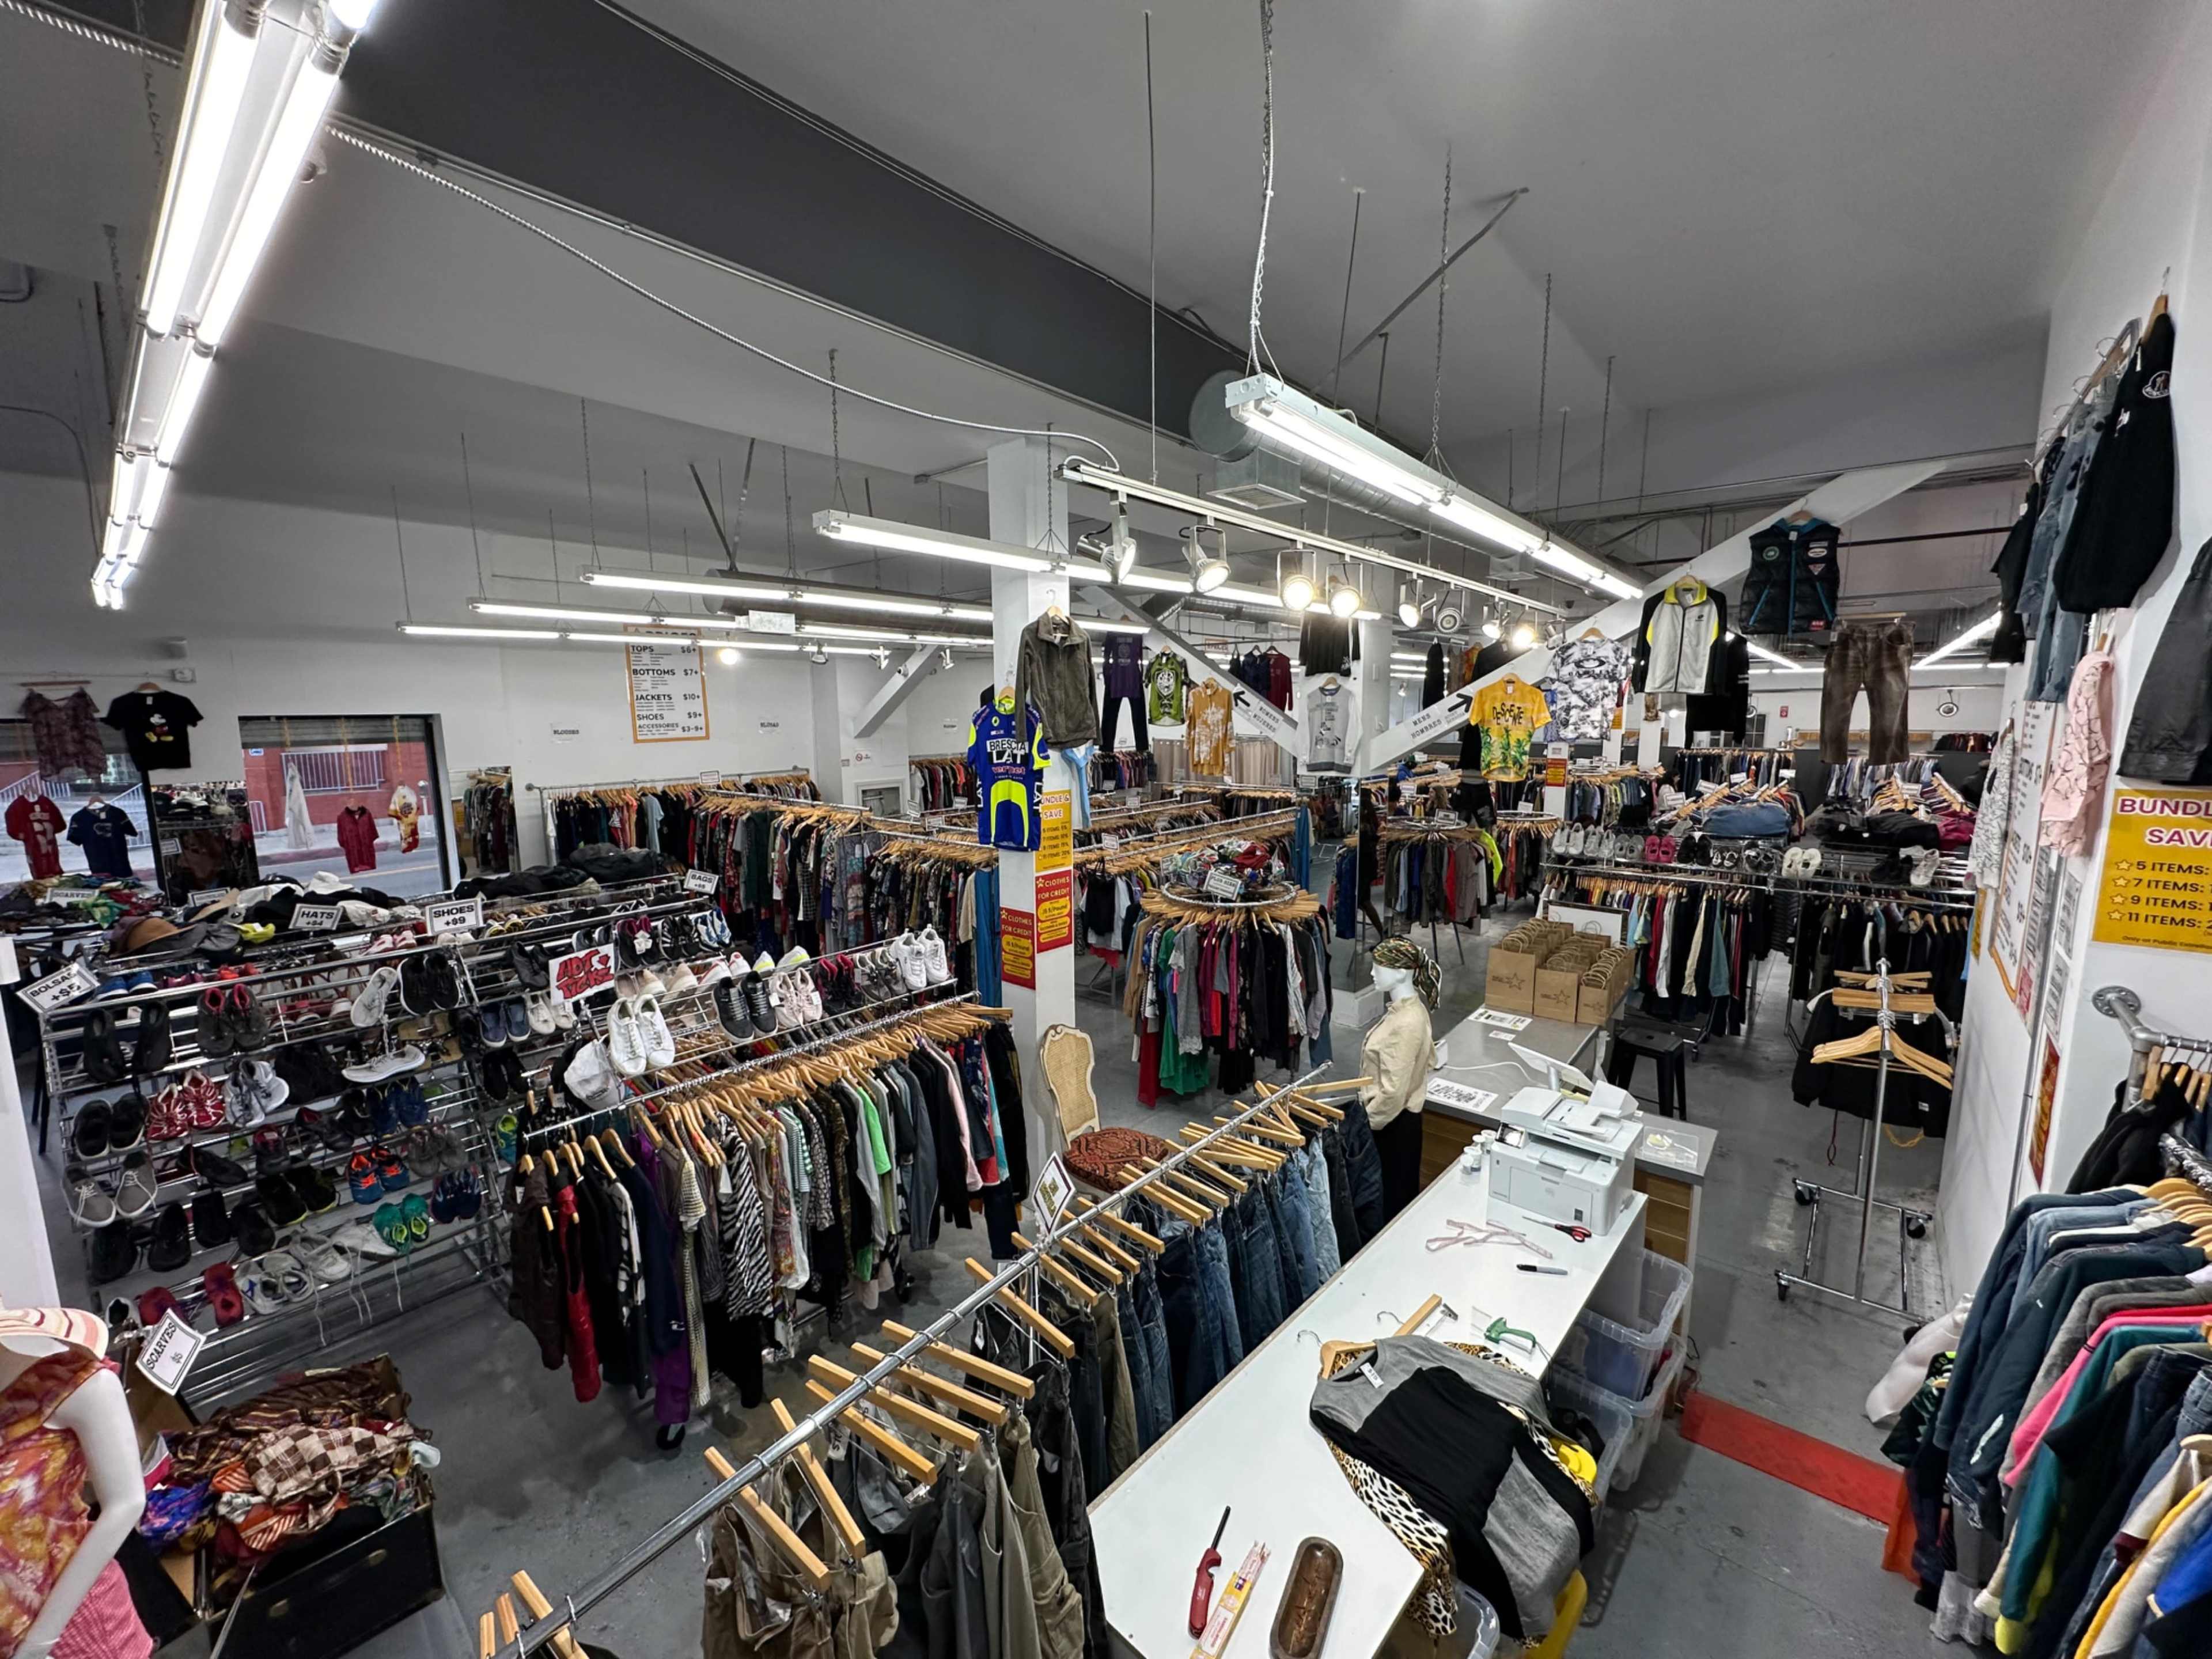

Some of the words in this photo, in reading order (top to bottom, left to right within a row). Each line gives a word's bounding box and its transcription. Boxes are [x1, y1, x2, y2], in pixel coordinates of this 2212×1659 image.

[989, 738, 1026, 751] BRESCIA
[993, 749, 1025, 764] LAT
[1041, 795, 1063, 804] UNDLE
[1044, 809, 1063, 818] SAVE
[2137, 861, 2146, 870] 5
[2151, 862, 2210, 876] ITEMS:
[691, 874, 713, 884] BAGS
[1045, 876, 1070, 887] CLOTHES
[2133, 878, 2143, 888] 7
[2147, 880, 2205, 893] ITEMS:
[1050, 887, 1070, 897] CREDIT
[2131, 895, 2141, 905] 9
[2145, 897, 2202, 911] ITEMS:
[301, 910, 334, 919] HATS
[433, 905, 475, 918] SHOES
[1008, 915, 1032, 926] CLOTHES
[2128, 912, 2139, 922] 11
[2145, 914, 2200, 928] ITEMS:
[556, 949, 600, 982] HOT
[29, 971, 76, 997] BOLSAS
[51, 982, 81, 1001] +$5
[146, 1322, 176, 1369] SCARVES
